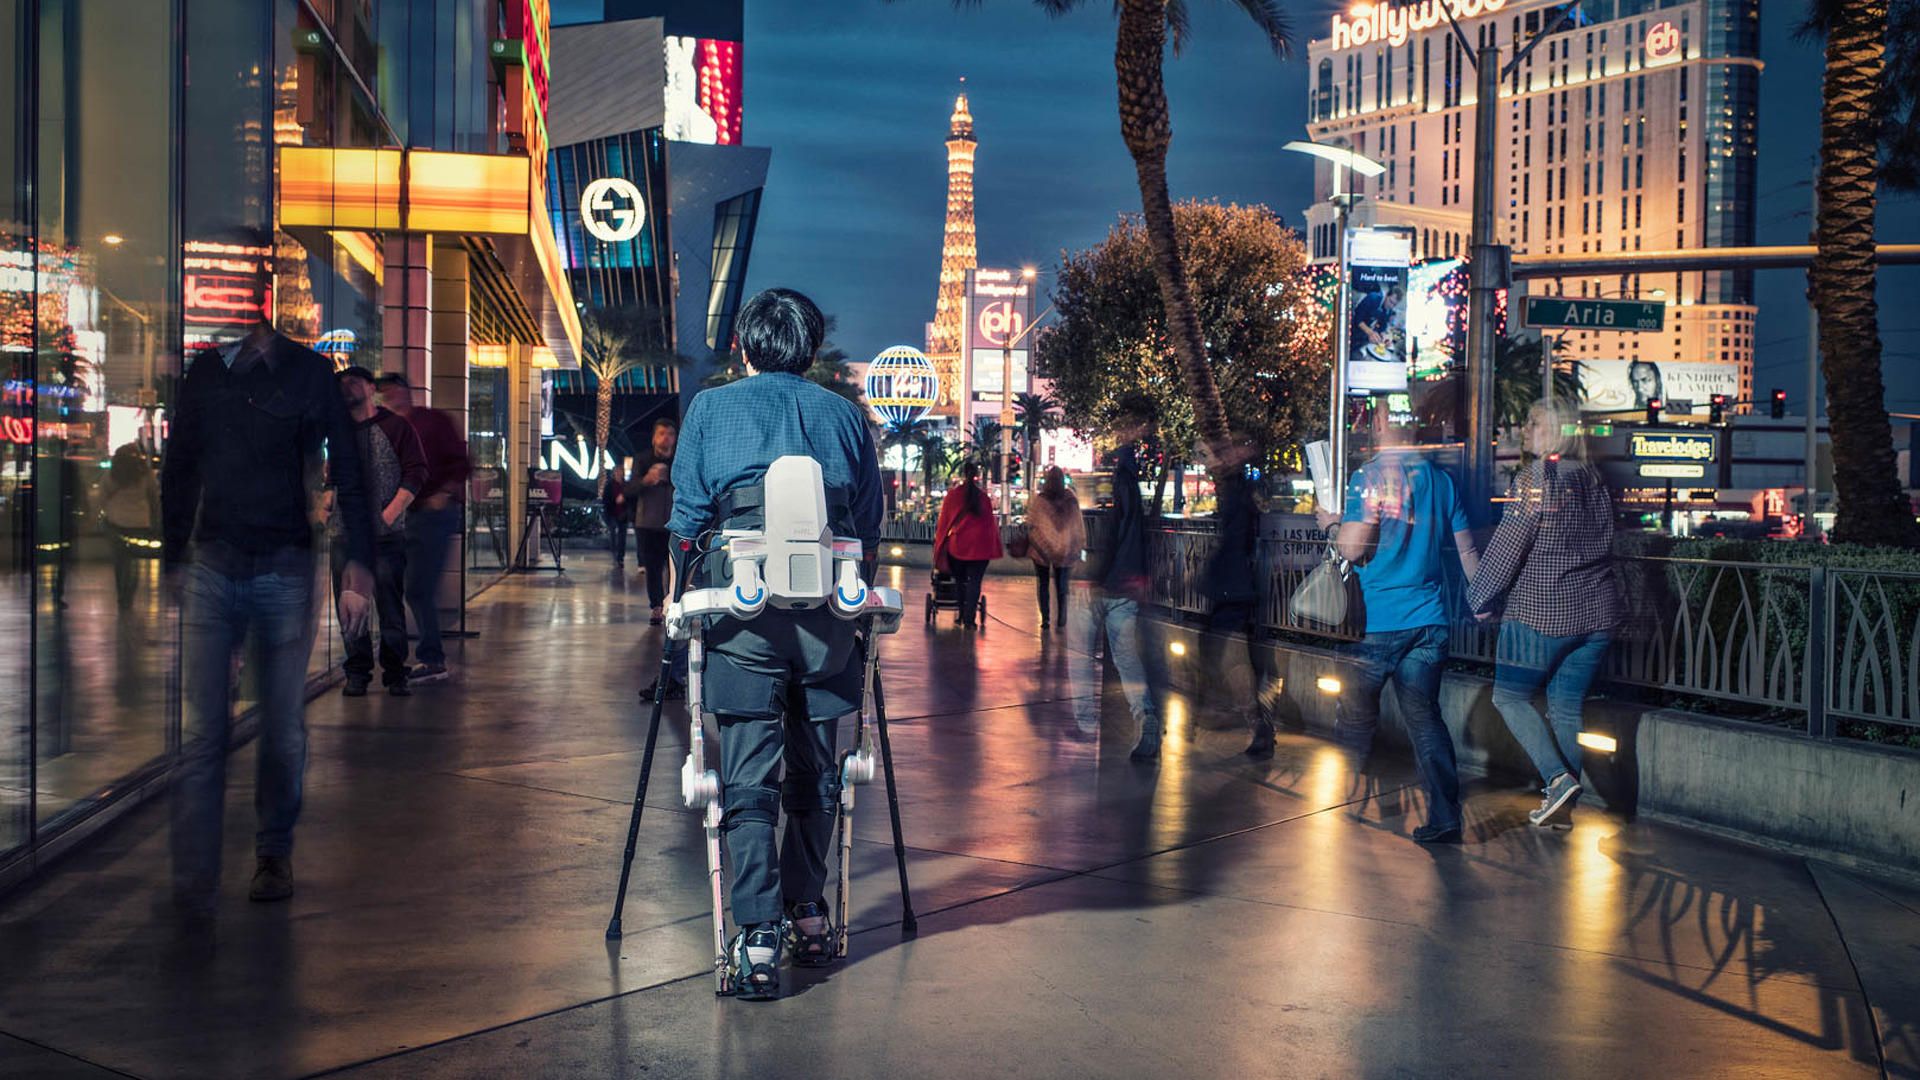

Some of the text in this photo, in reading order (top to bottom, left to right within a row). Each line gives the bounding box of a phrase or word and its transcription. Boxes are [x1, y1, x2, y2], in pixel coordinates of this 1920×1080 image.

[1332, 0, 1507, 50] hollywoo
[1360, 273, 1376, 281] Hard
[1564, 303, 1615, 325] Aria
[1637, 318, 1657, 328] 1000
[1667, 371, 1736, 384] KENDRICK
[1632, 436, 1710, 459] Travelodge
[1284, 529, 1303, 541] LAS
[1284, 543, 1314, 555] STRIP
